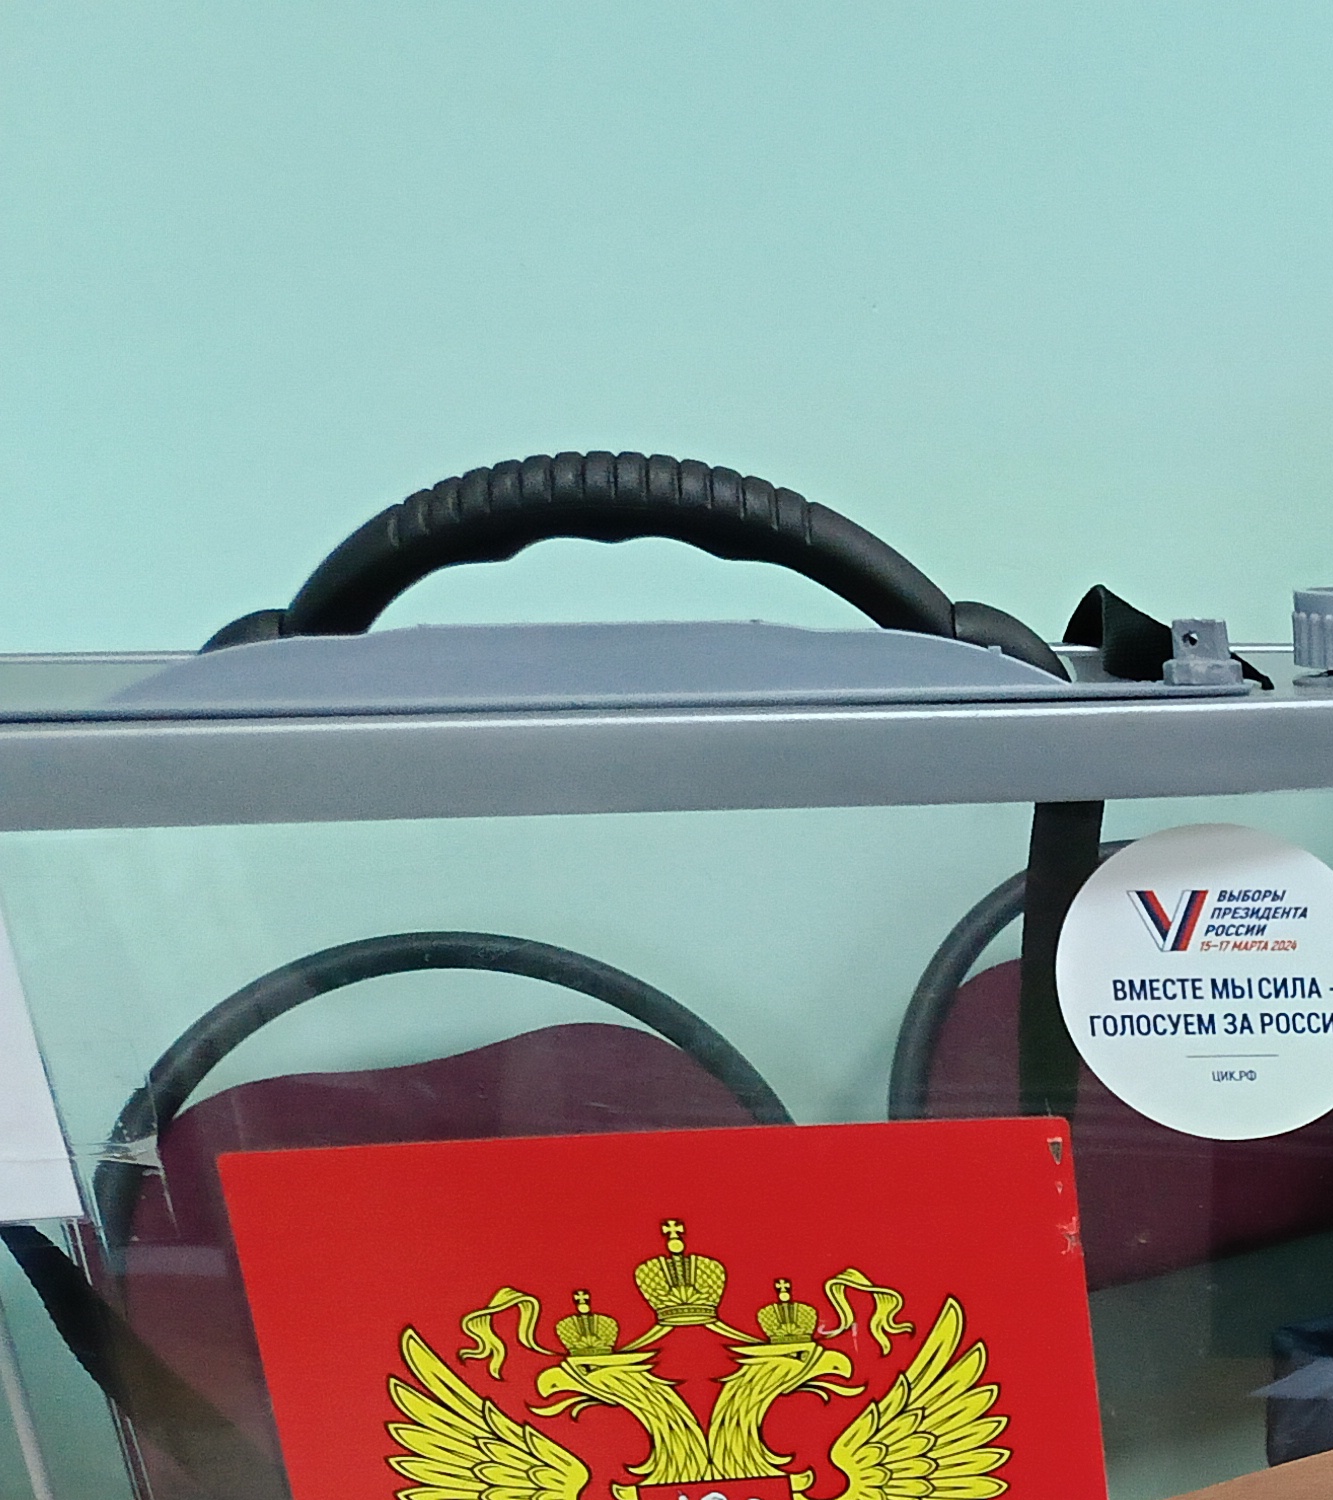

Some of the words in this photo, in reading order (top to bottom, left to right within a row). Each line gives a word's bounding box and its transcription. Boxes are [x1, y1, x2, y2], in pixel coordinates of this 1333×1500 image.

[1216, 889, 1287, 903] ВЫБОРЫ
[1210, 906, 1308, 921] ПРЕЗИДЕНТА
[1203, 924, 1268, 937] РОССИИ
[1231, 940, 1270, 952] МАРТА
[1270, 940, 1298, 952] 2024
[1112, 978, 1204, 1001] ВМЕСТЕ
[1211, 977, 1253, 1000] МЫ
[1257, 977, 1322, 999] СИЛА
[1089, 1014, 1217, 1037] ГОЛОСУЕМ
[1223, 1013, 1255, 1035] ЗА
[1211, 1069, 1257, 1083] ЦИК.РФ
